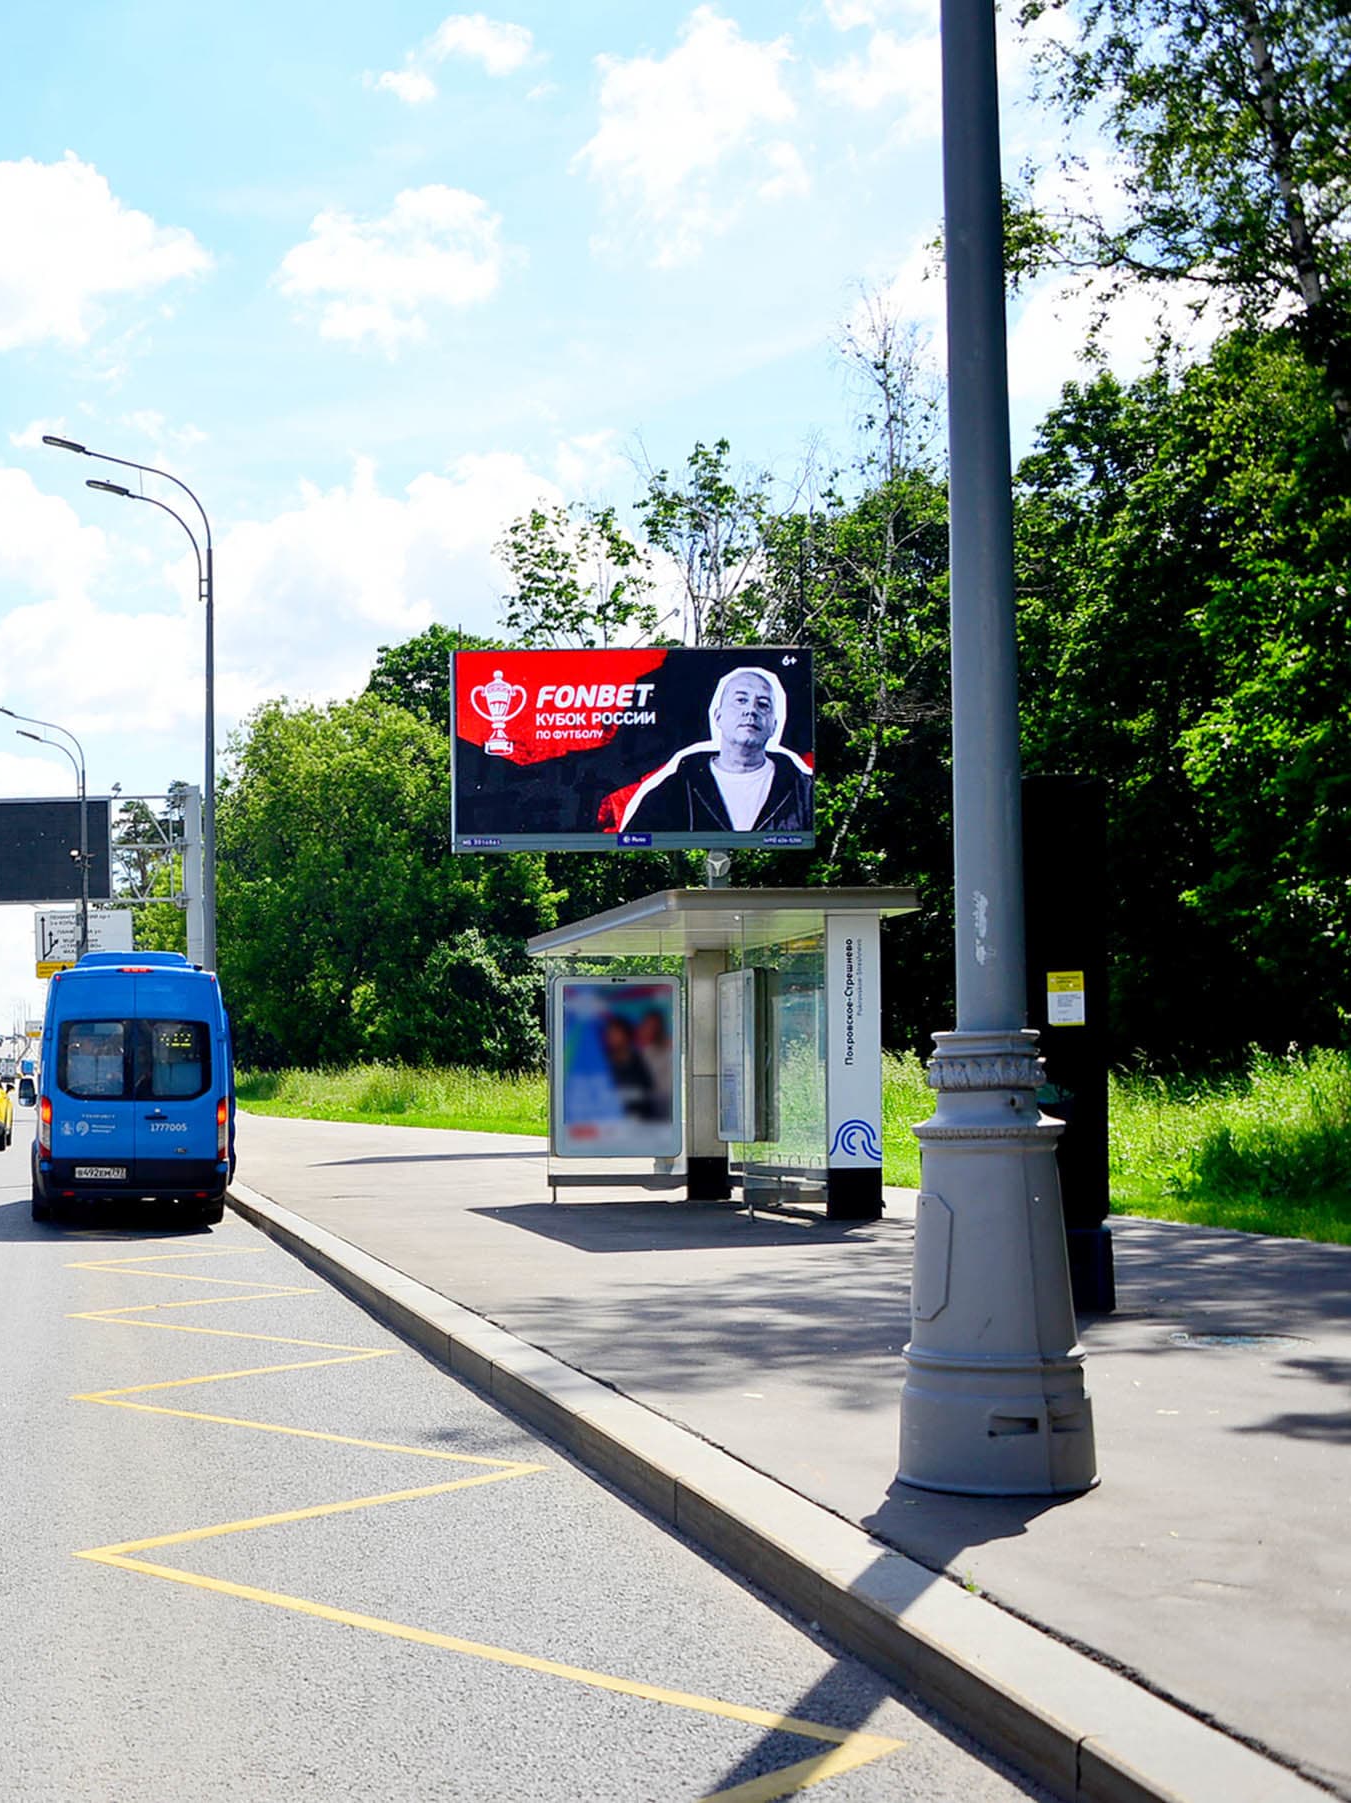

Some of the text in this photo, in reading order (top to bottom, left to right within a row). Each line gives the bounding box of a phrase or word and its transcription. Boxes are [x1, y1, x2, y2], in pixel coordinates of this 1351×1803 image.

[782, 655, 797, 666] 6+
[535, 684, 655, 708] FONBET
[536, 711, 656, 726] КУБОК РОССИИ
[536, 729, 604, 739] ПО ФУТБОЛУ
[843, 938, 855, 1066] Покровское-Стрешнево
[150, 1123, 187, 1132] 1777005
